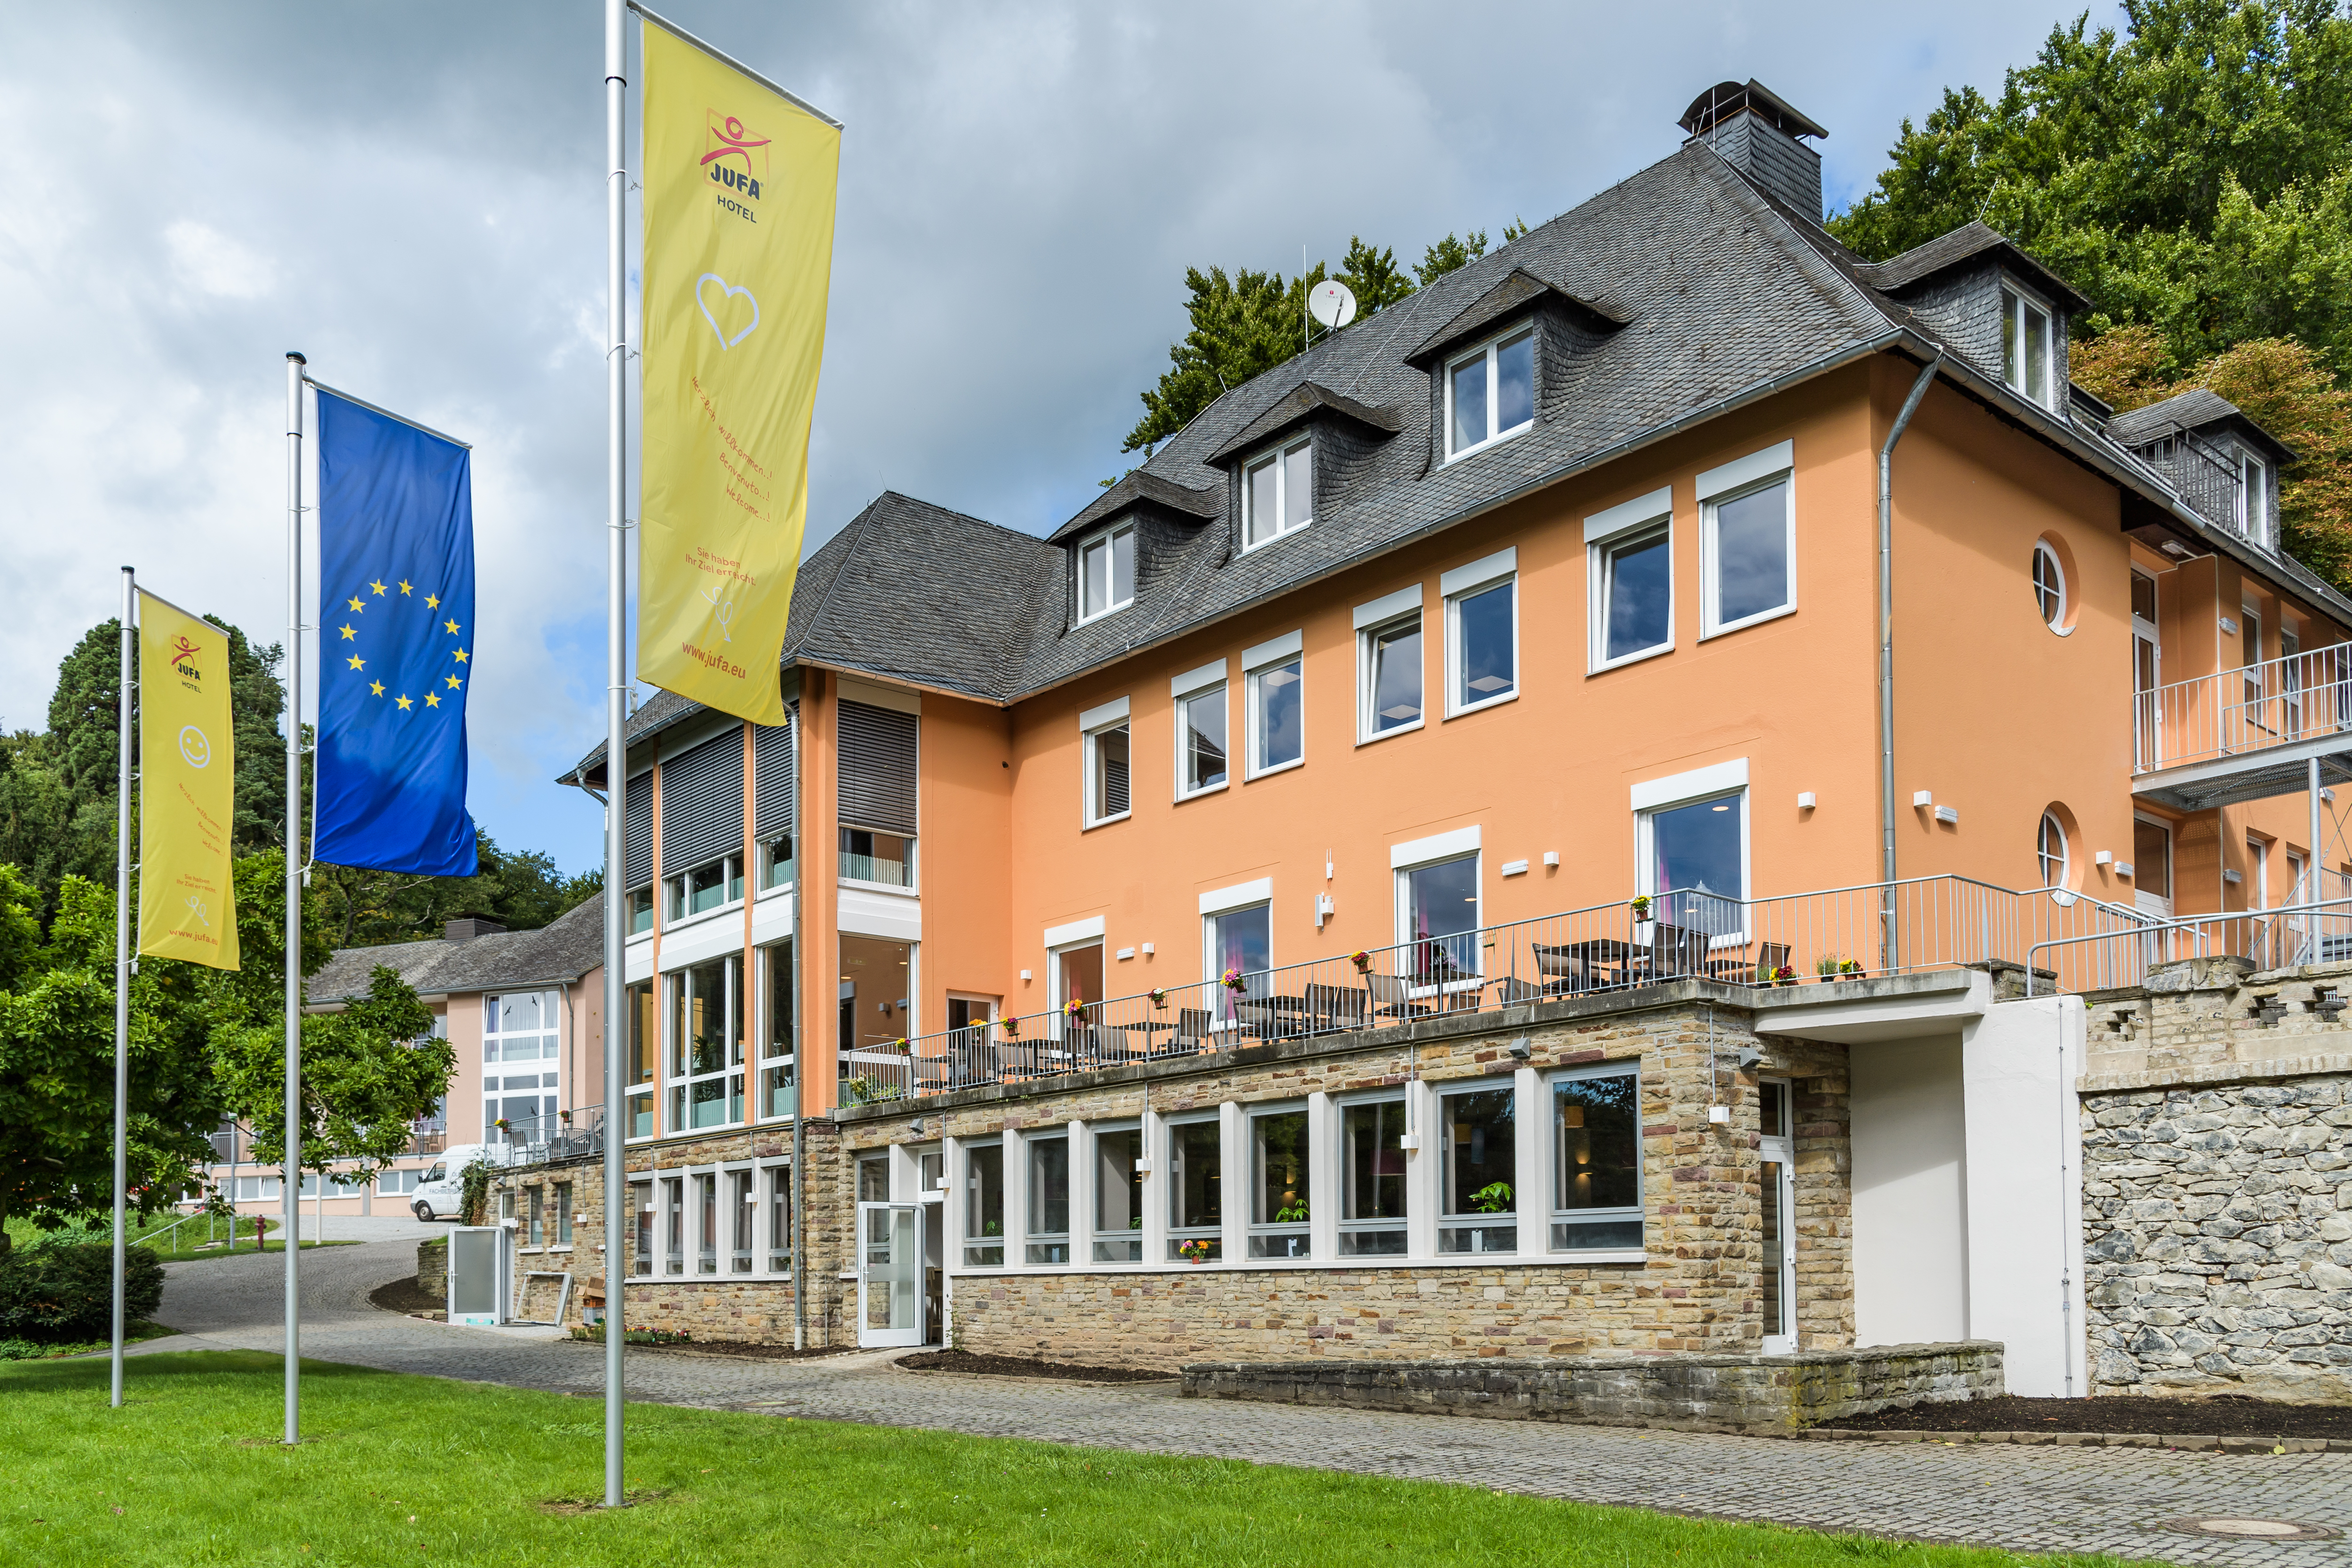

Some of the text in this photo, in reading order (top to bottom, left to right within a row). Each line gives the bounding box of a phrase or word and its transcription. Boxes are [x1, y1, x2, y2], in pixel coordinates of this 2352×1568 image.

[710, 163, 760, 200] JUFA
[717, 194, 757, 224] HOTEL
[691, 376, 716, 422] Herzlich
[685, 553, 756, 586] Ihr Ziel erreicht.
[697, 547, 741, 569] Sie haben
[682, 642, 746, 680] www.jufa.eu
[182, 680, 202, 693] HOTEL
[193, 876, 210, 884] haben
[169, 930, 218, 946] www.jufa.eu
